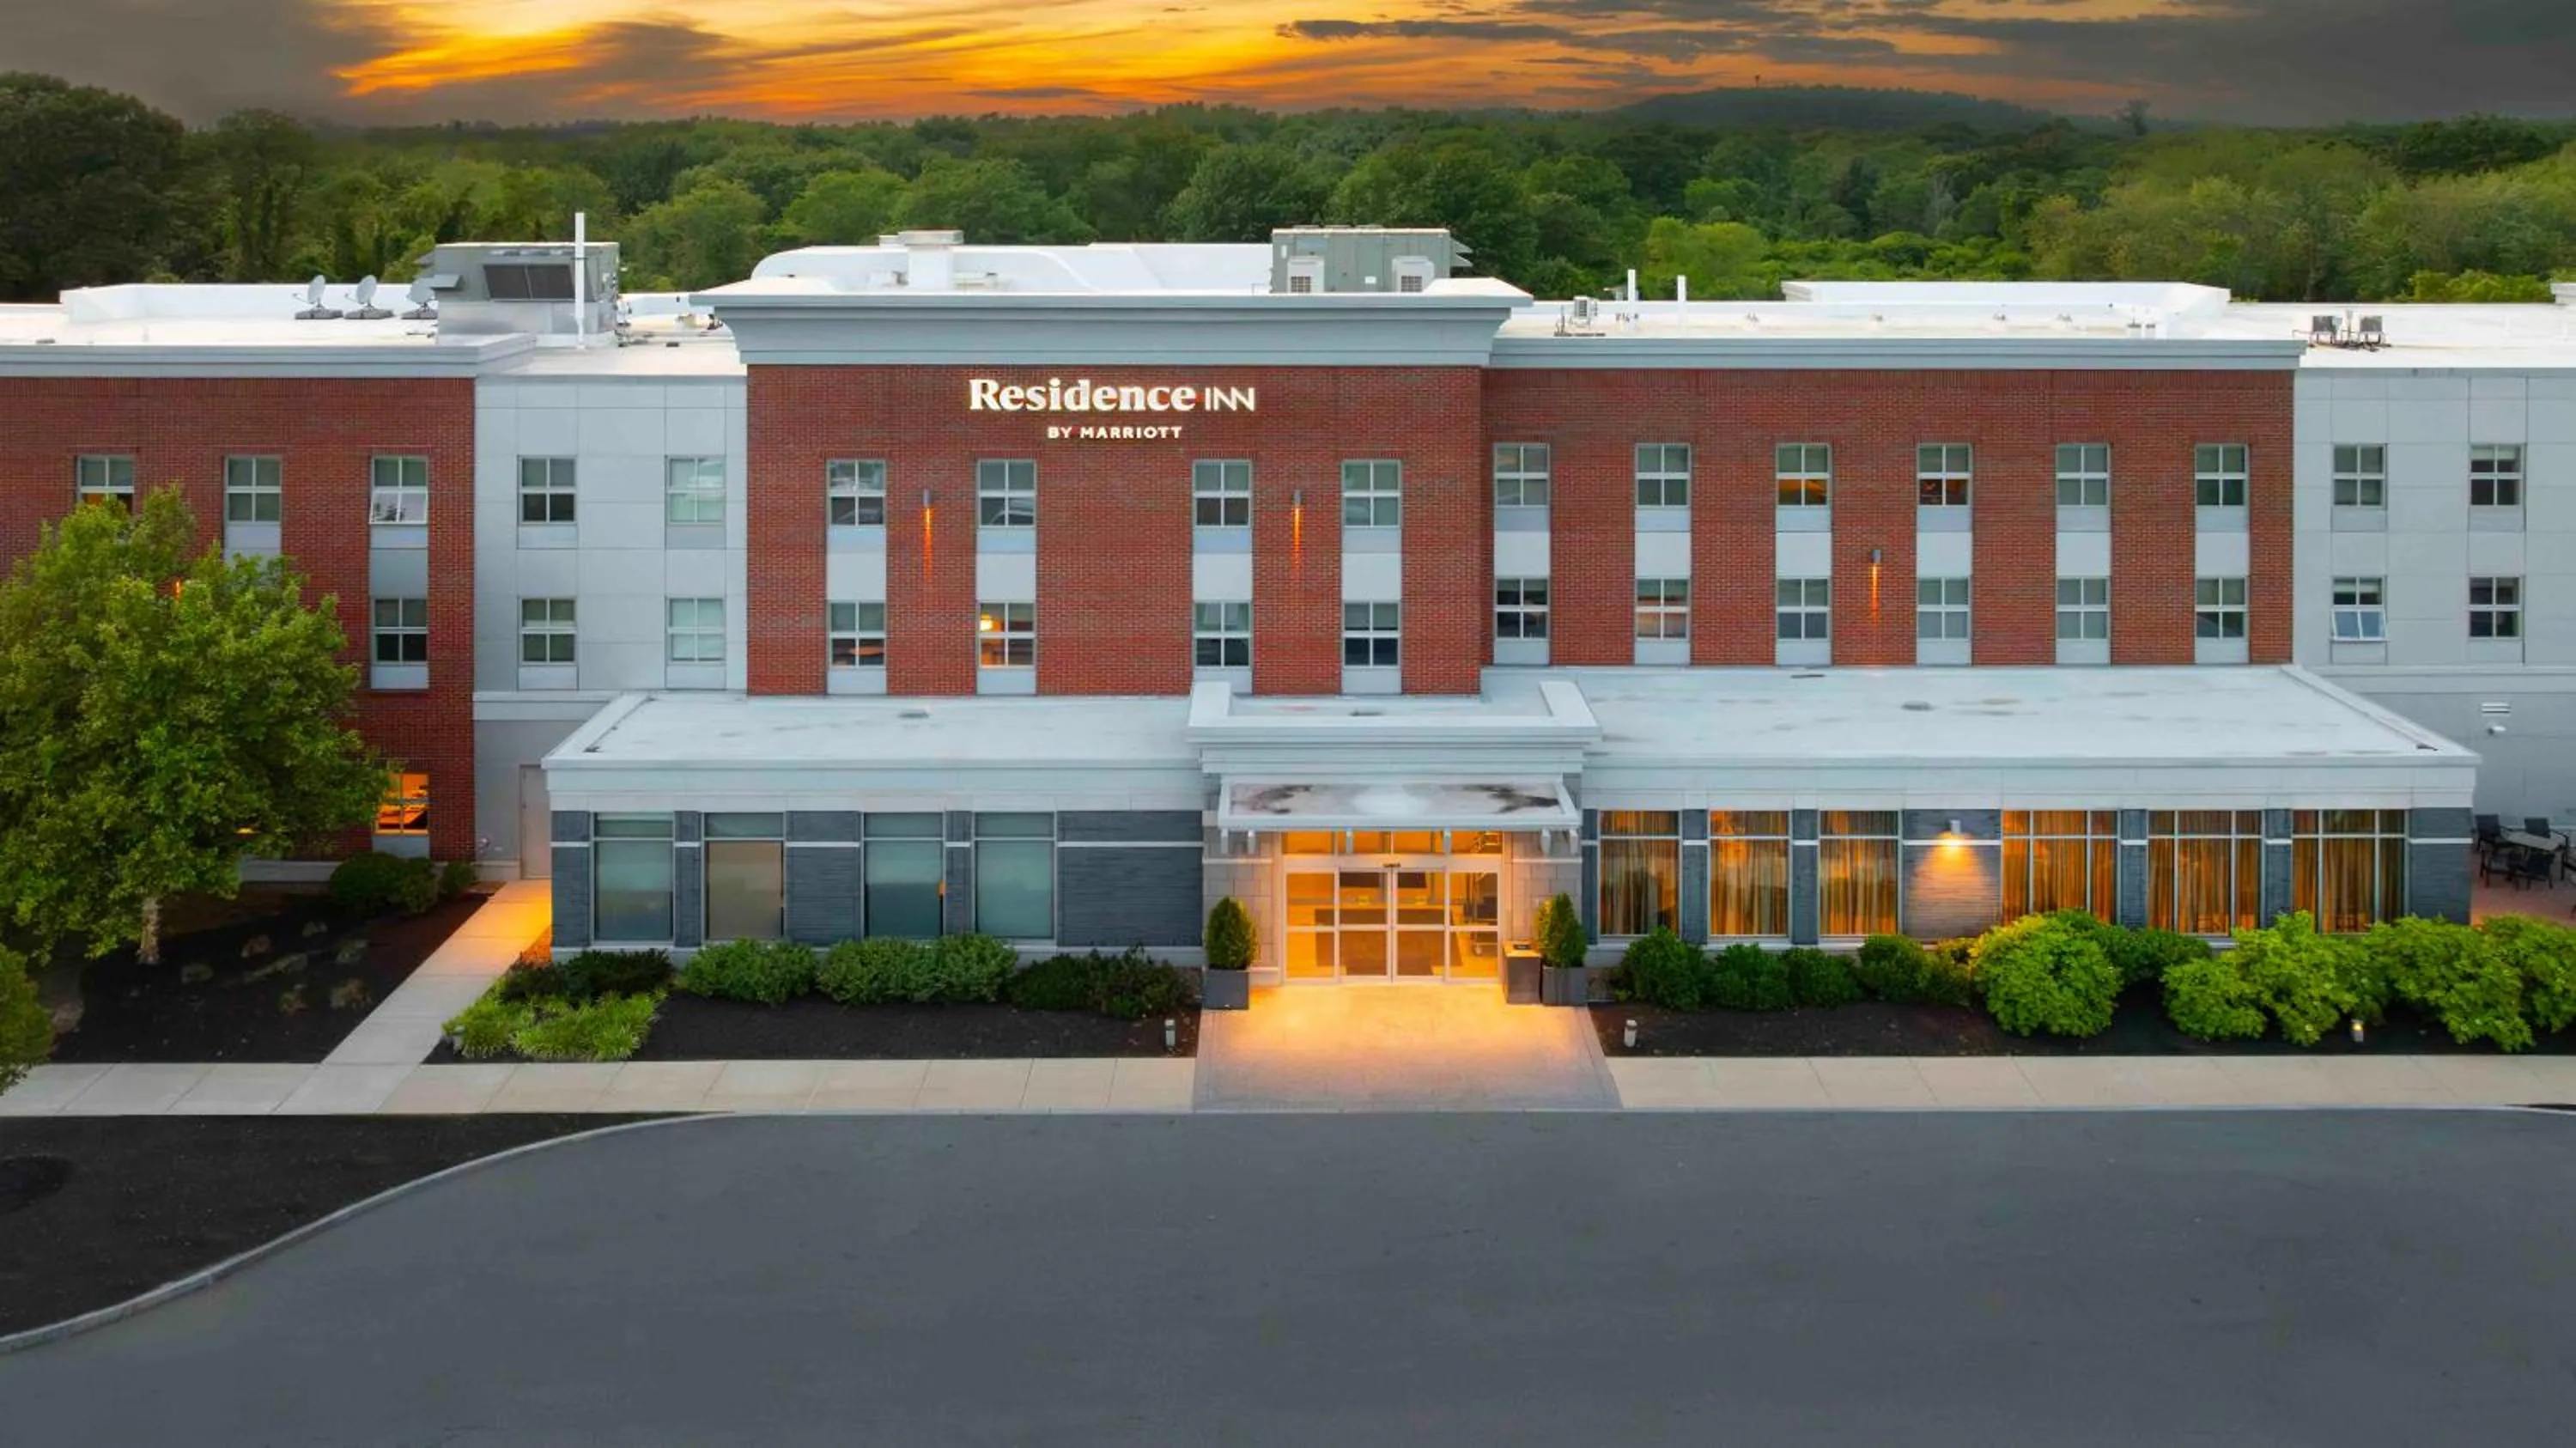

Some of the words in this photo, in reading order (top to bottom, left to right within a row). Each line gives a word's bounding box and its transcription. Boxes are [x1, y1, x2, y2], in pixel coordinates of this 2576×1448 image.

[969, 378, 1196, 411] Residence
[1205, 386, 1255, 411] INN
[1047, 426, 1072, 439] BY
[1079, 426, 1182, 439] MARRIOTT
